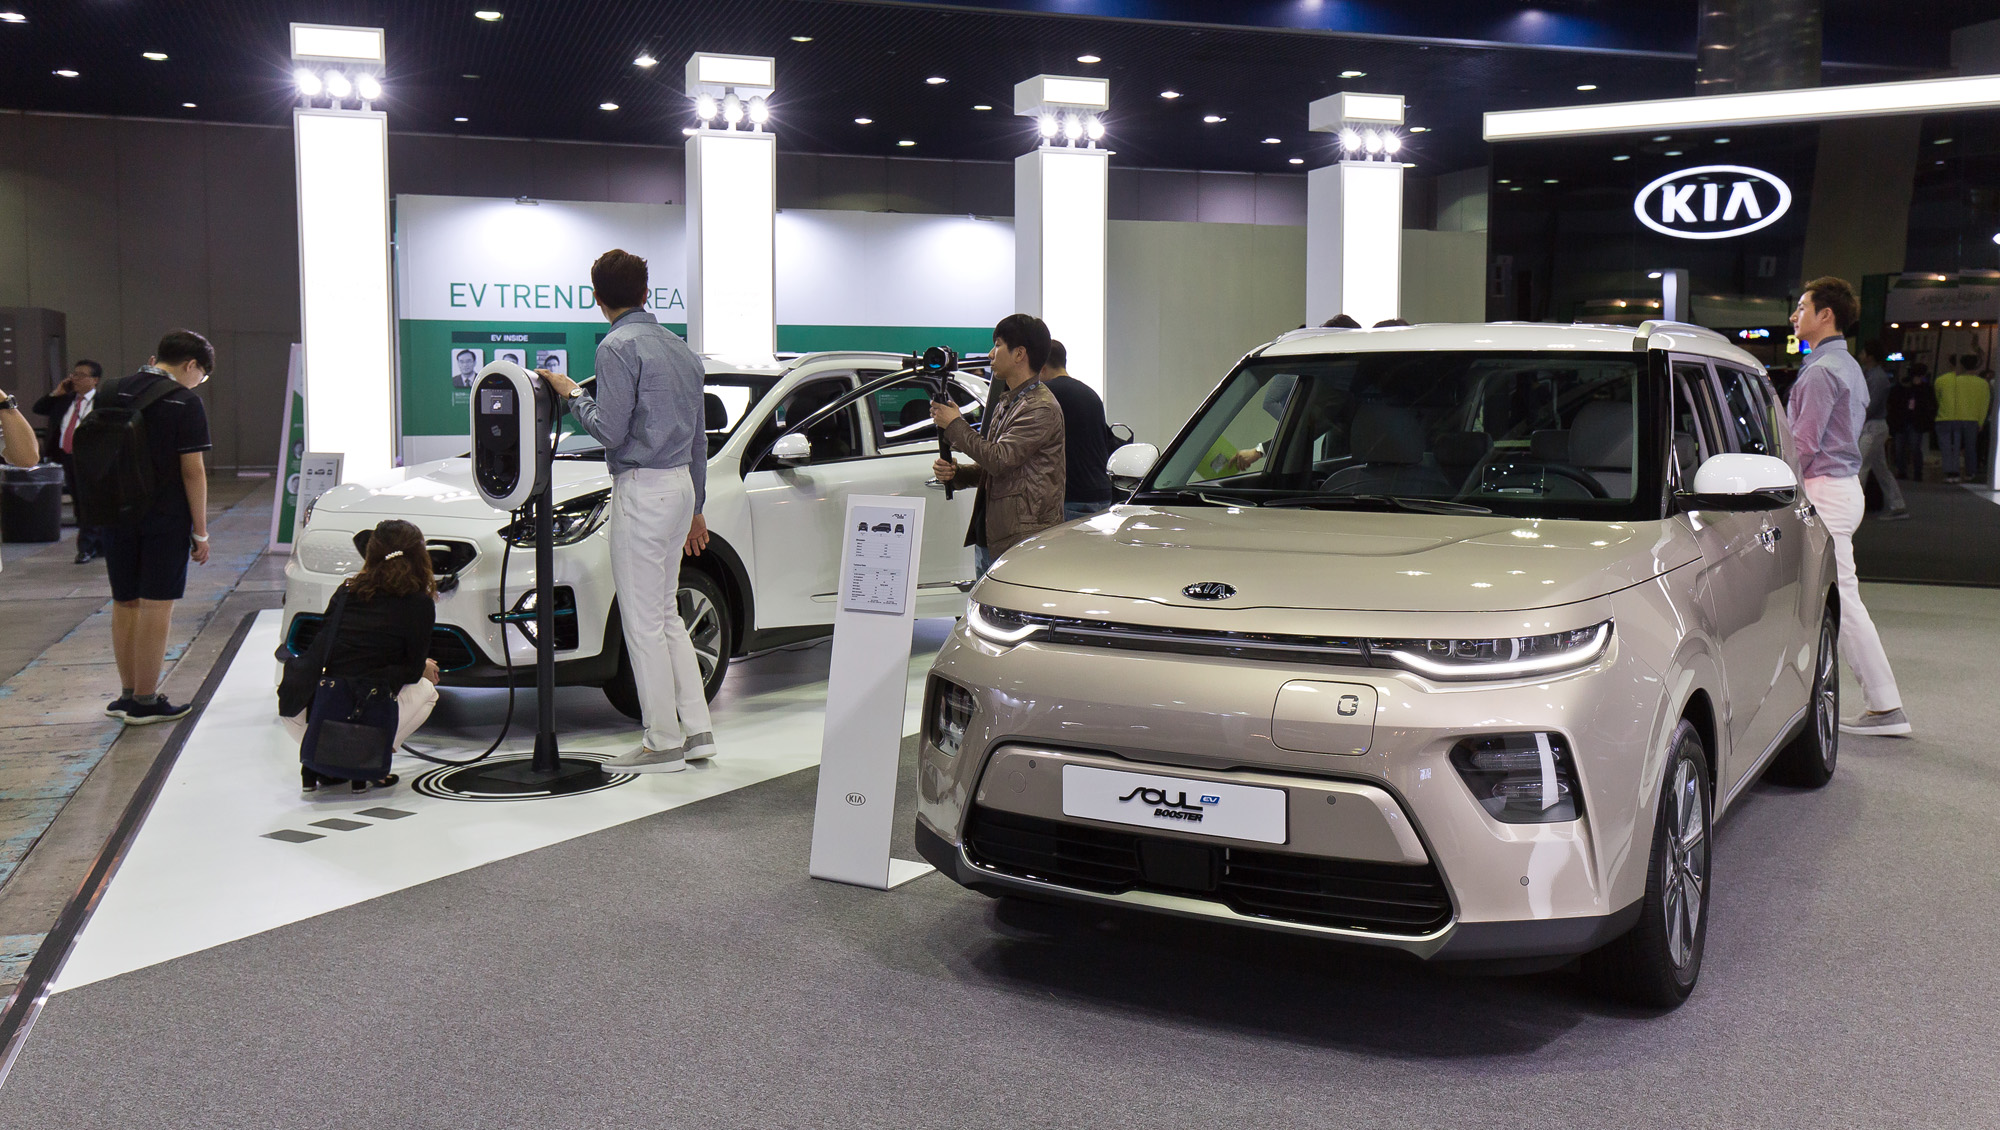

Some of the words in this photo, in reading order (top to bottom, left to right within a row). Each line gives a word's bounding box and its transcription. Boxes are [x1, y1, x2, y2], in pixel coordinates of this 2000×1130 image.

[1662, 182, 1762, 222] KIA
[450, 283, 487, 308] EV
[494, 284, 594, 309] TREND
[490, 334, 502, 342] EV
[503, 334, 529, 342] INSIDE
[1189, 583, 1225, 595] KIA
[849, 795, 863, 804] KIA
[1119, 786, 1203, 811] SOUL
[1154, 808, 1203, 821] BOOSTER
